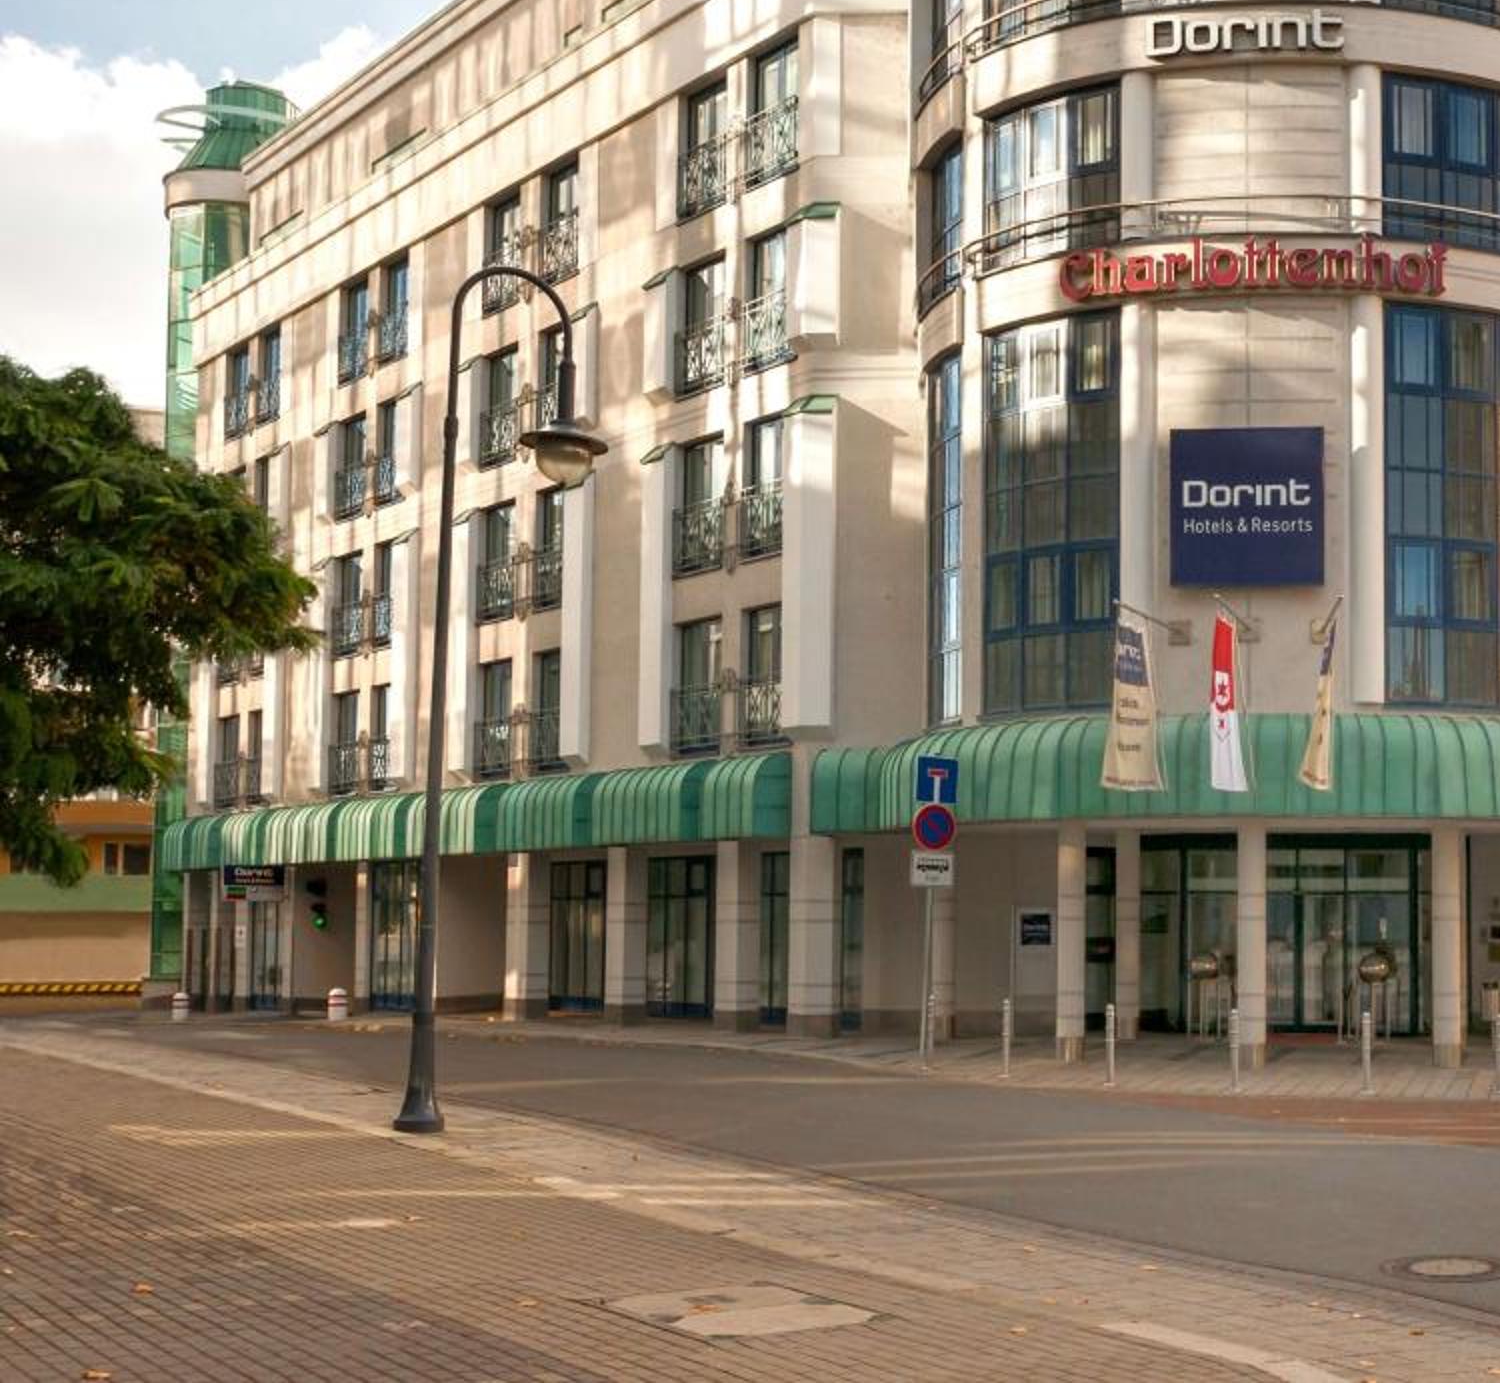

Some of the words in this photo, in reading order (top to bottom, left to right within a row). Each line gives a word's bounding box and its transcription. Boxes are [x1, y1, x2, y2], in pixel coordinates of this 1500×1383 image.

[1145, 8, 1345, 57] Dorint
[1059, 236, 1448, 302] Charlottenhof
[1182, 478, 1311, 507] Dorint
[1183, 518, 1233, 534] Hotels
[1237, 517, 1248, 533] &
[1251, 516, 1313, 533] Resorts
